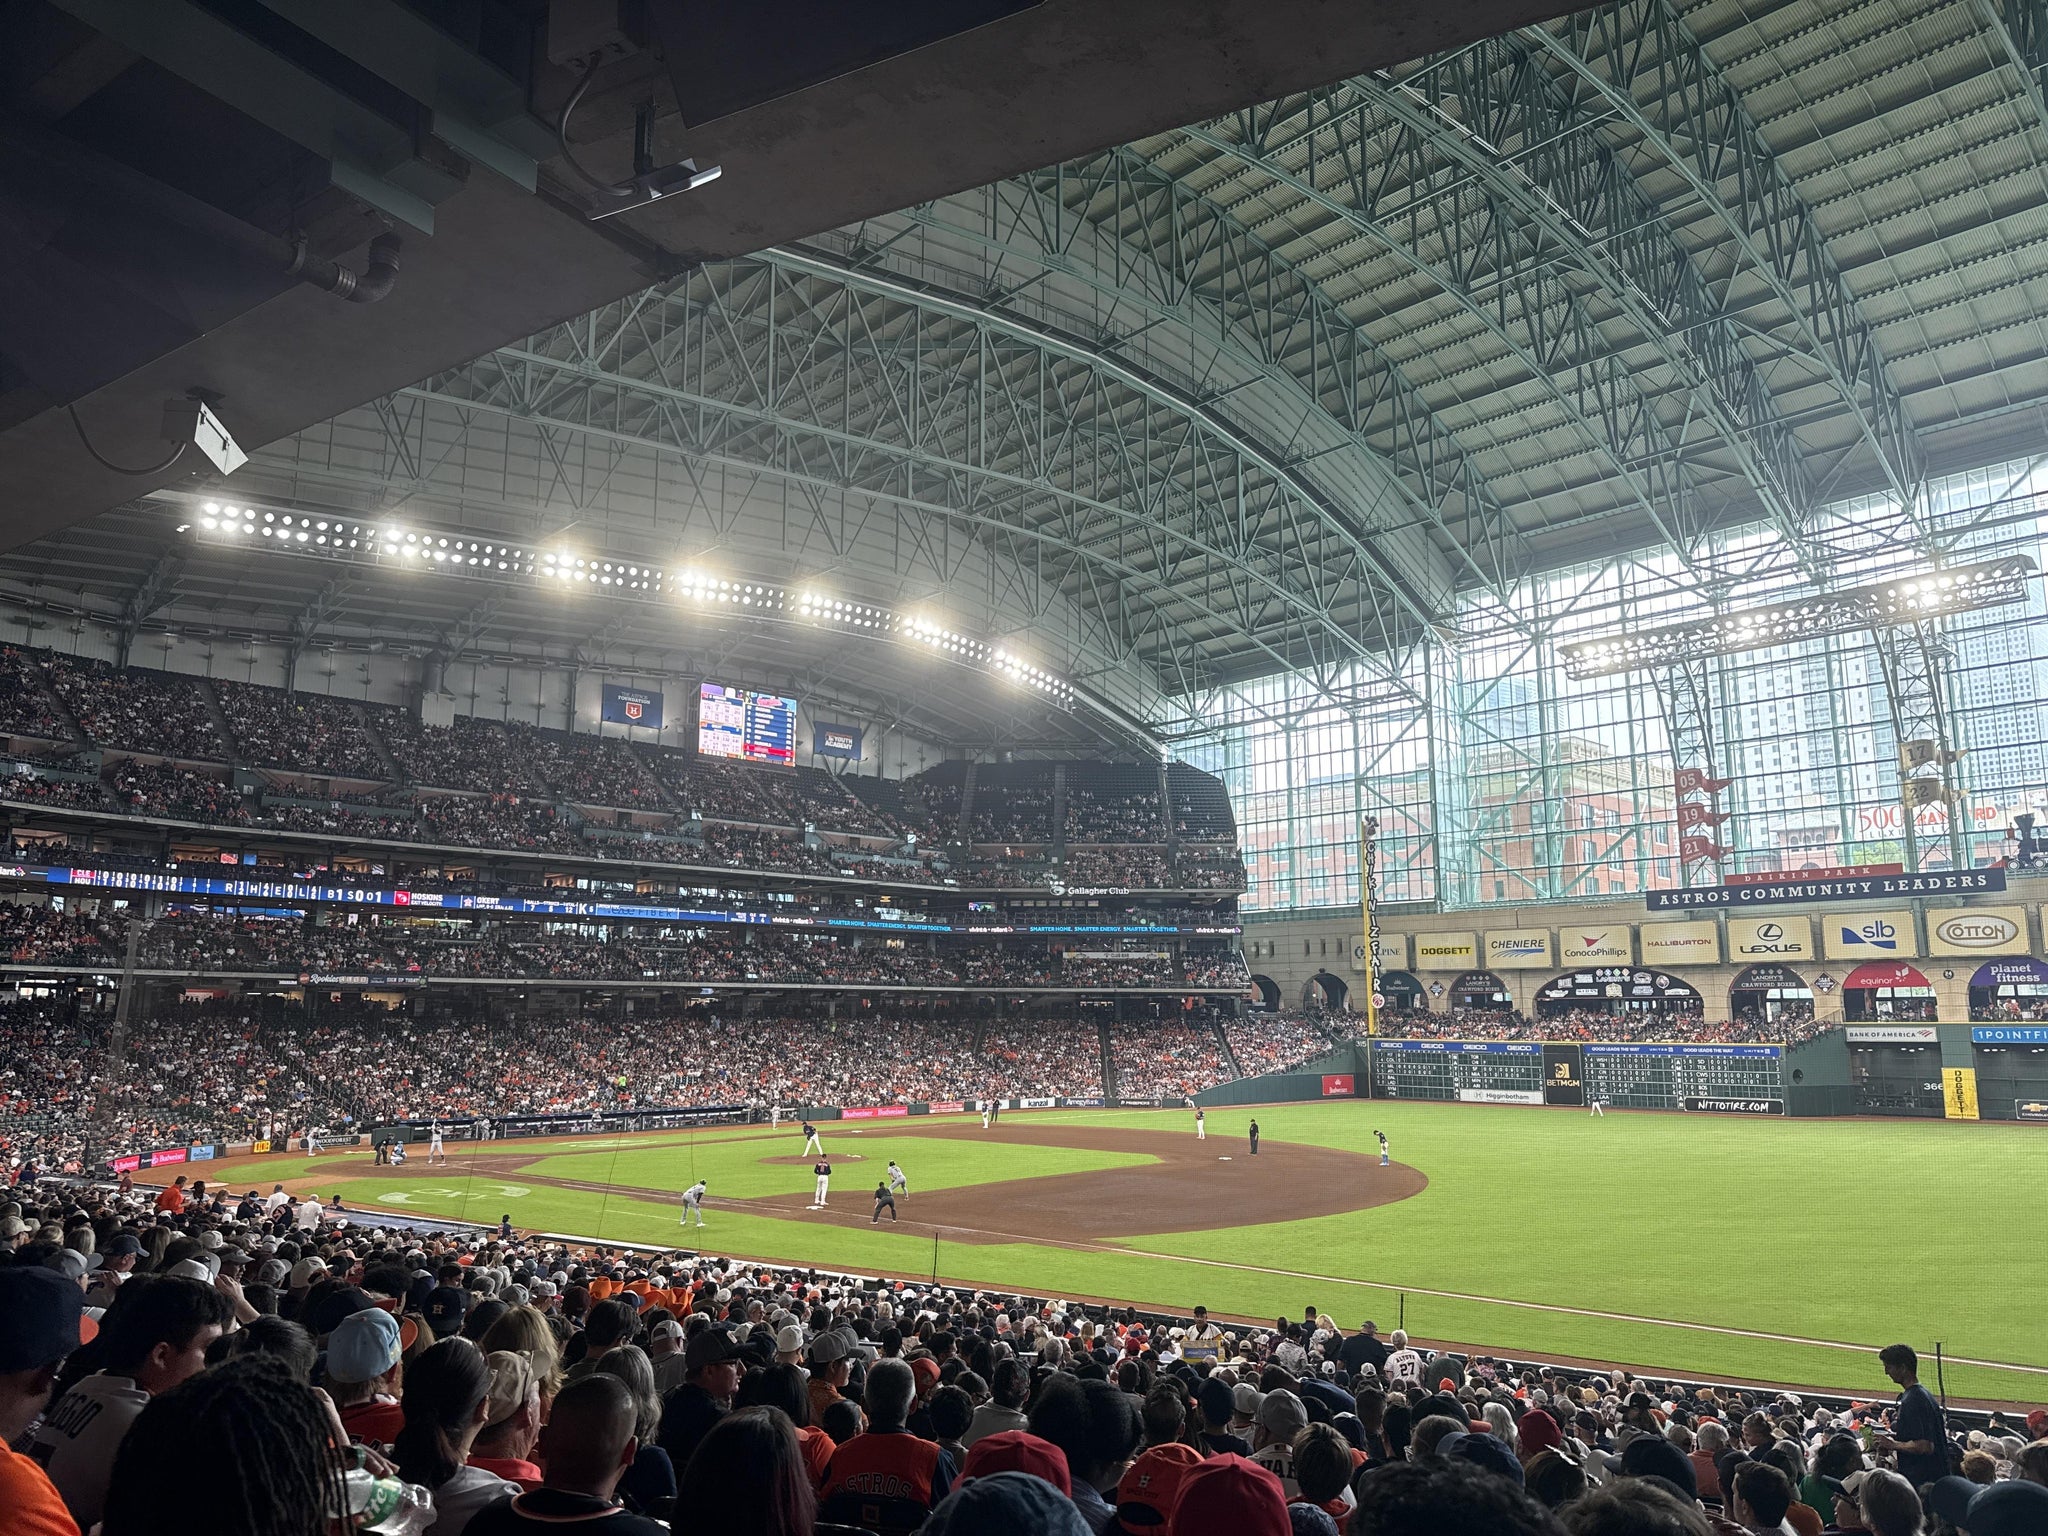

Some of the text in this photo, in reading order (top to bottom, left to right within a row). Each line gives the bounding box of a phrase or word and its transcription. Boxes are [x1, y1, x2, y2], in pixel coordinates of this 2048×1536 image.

[1907, 745, 1925, 761] 17
[1680, 774, 1695, 788] 05
[1910, 786, 1929, 799] 22
[1684, 809, 1698, 822] 19
[1685, 841, 1699, 854] 21
[1366, 840, 1377, 912] CHIKIN
[1745, 868, 1870, 882] DAIKIN PARK
[225, 883, 233, 892] R
[250, 885, 258, 894] H
[275, 886, 282, 895] E
[299, 888, 305, 896] L
[1068, 887, 1108, 896] Gallagher
[1660, 875, 1987, 905] ASTROS COMMUNITY LEADERS
[411, 893, 443, 901] HOSKINS
[579, 903, 587, 914] K
[1369, 914, 1380, 938] IZ
[1863, 920, 1895, 938] slb
[1946, 923, 2005, 940] COTTON
[1491, 939, 1544, 949] CHENIERE
[1647, 939, 1711, 947] HALLIBURTON
[1740, 943, 1802, 954] LEXUS
[1421, 947, 1471, 955] DOGGETT
[1565, 949, 1627, 958] ConocoPhillips
[1369, 941, 1381, 993] FAIR
[1990, 964, 2031, 976] planet
[310, 974, 339, 984] Rookies
[1996, 973, 2040, 983] fitness
[1955, 1070, 1964, 1113] DOGGETT
[1698, 1100, 1769, 1112] NITTOTIRE.COM
[159, 1153, 185, 1163] Budweiser
[432, 1304, 444, 1314] H
[1400, 1362, 1415, 1376] 27
[1139, 1476, 1151, 1488] H
